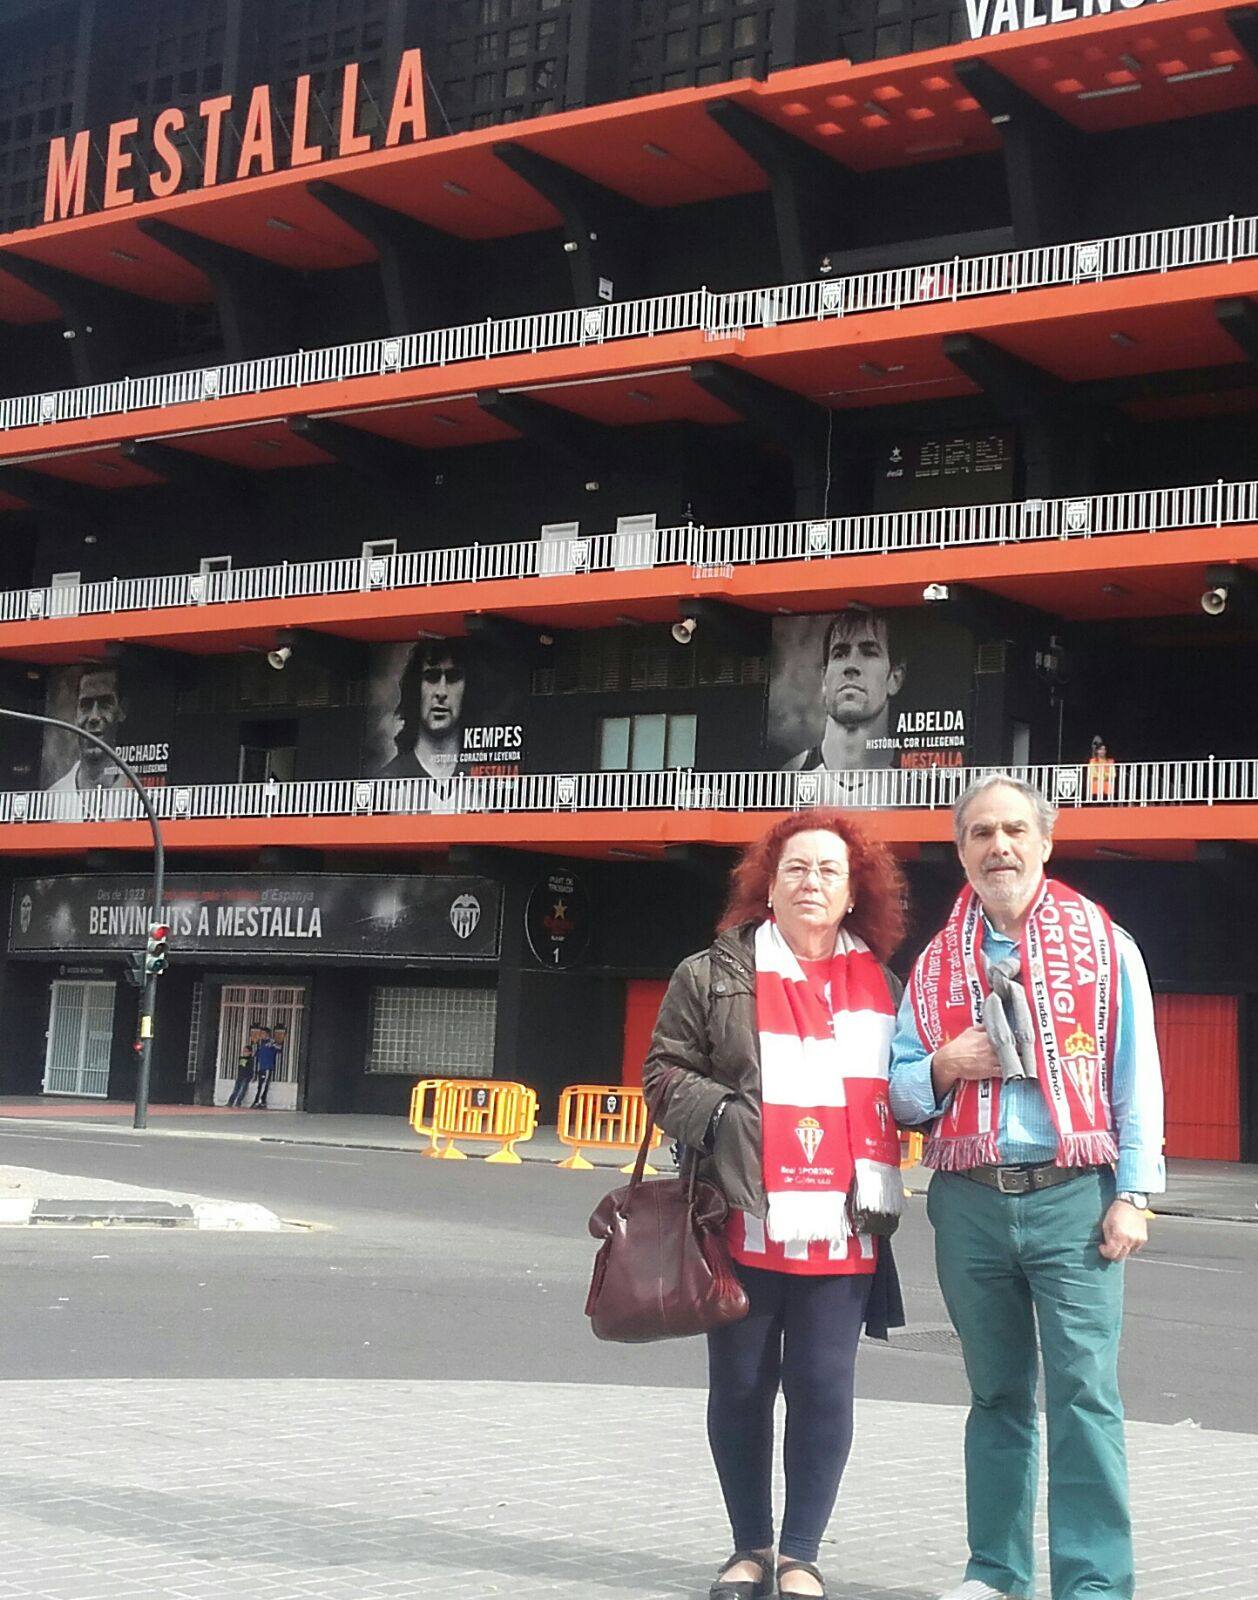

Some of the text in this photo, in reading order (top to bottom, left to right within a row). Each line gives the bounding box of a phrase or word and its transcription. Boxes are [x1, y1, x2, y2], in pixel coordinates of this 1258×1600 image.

[43, 48, 427, 222] MESTALLA
[897, 710, 965, 733] ALBELDA
[463, 726, 523, 749] KEMPES
[904, 737, 920, 748] COR
[926, 735, 965, 747] LLEGENDA
[494, 751, 521, 761] LEYENDA
[901, 751, 964, 768] MESTALLA
[197, 906, 210, 937] A
[216, 906, 322, 938] MESTALLA
[552, 947, 559, 964] 1
[1034, 981, 1062, 1101] Estadio El Molinón
